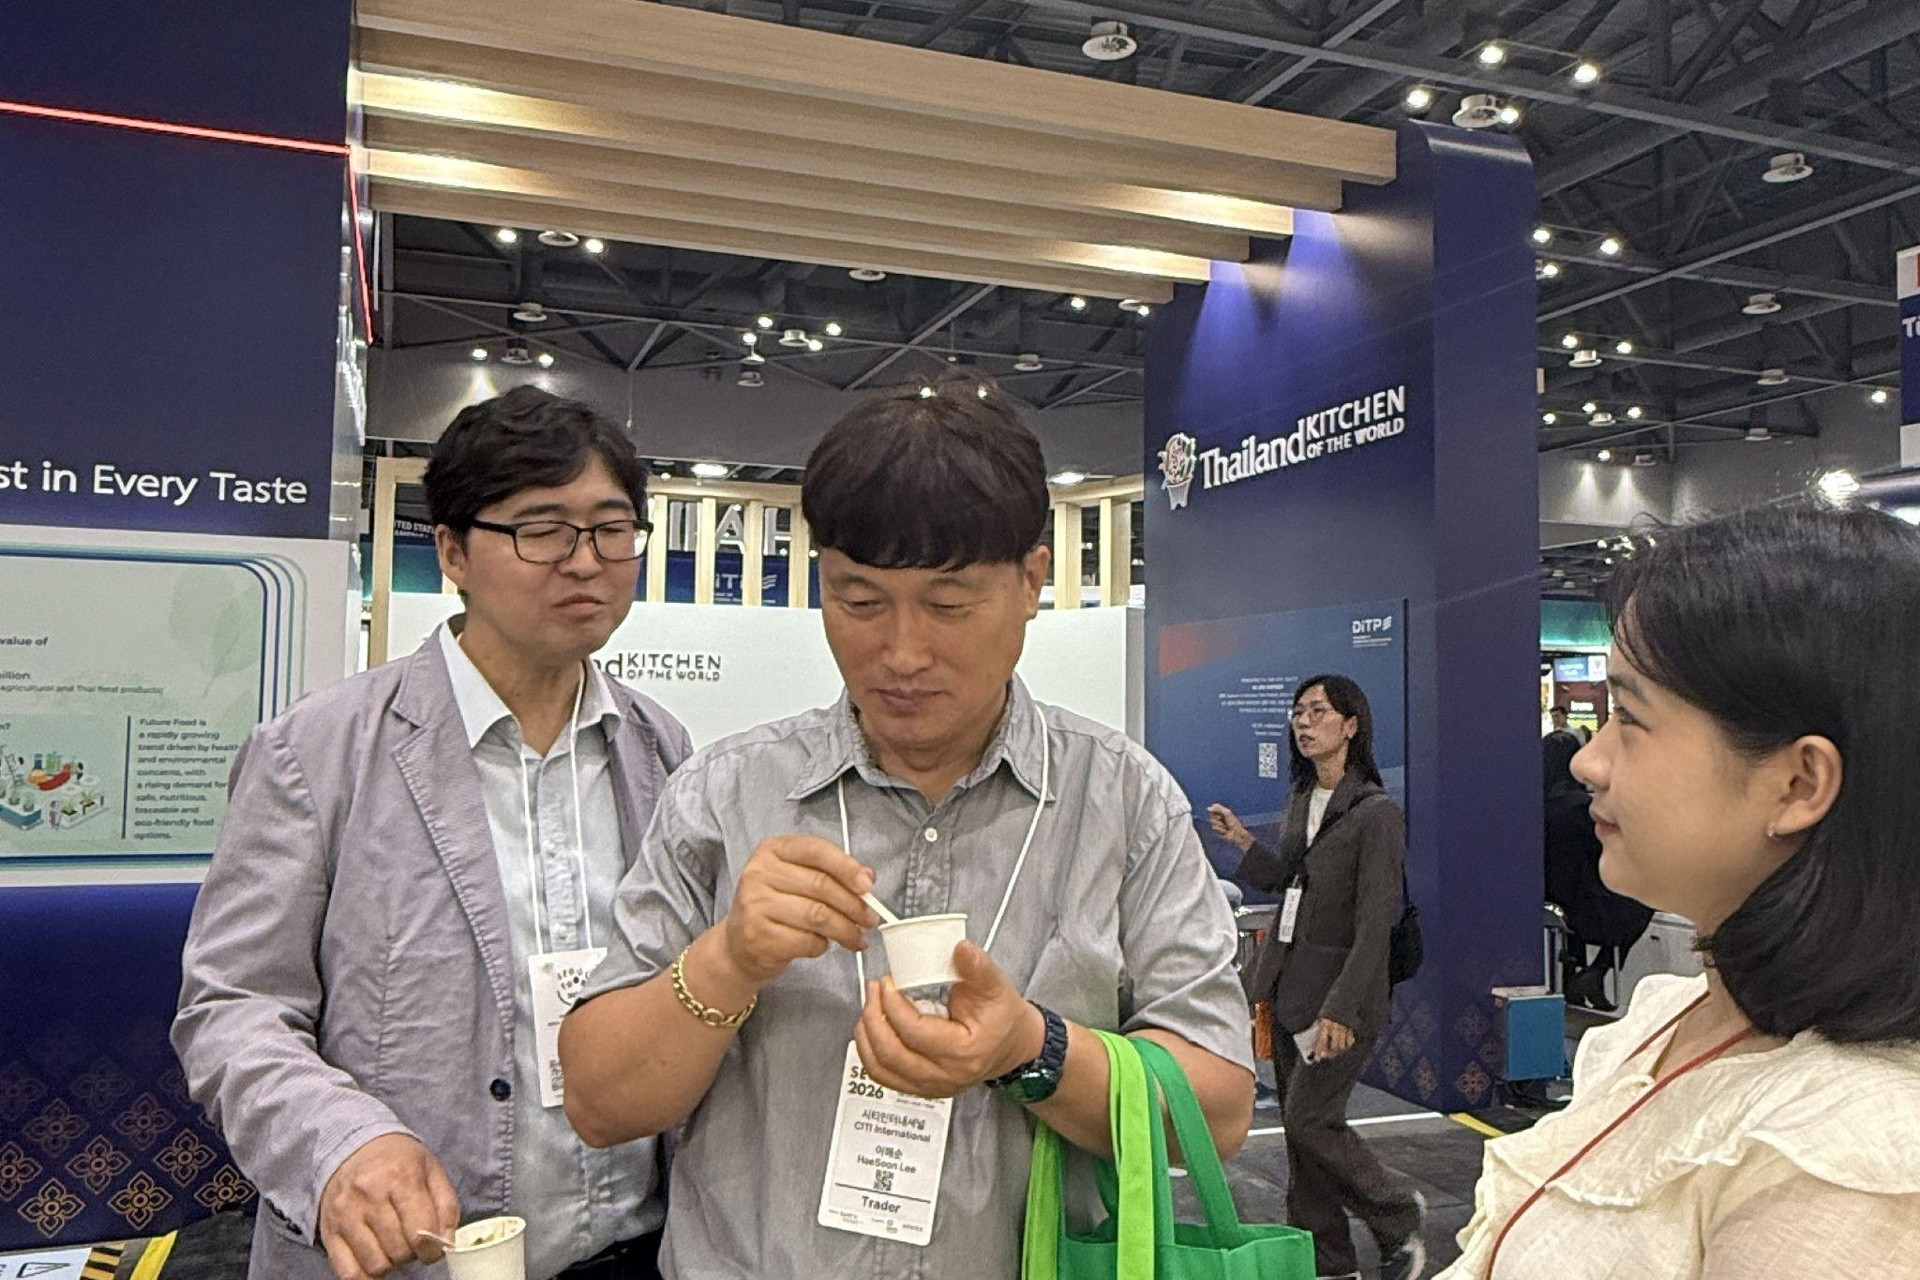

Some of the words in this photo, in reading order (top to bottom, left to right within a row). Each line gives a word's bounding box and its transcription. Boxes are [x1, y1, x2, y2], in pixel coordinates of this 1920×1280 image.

[1306, 385, 1405, 440] KITCHEN
[1307, 441, 1325, 459] OF
[1326, 433, 1353, 454] THE
[1354, 417, 1405, 445] WORLD
[1199, 418, 1306, 490] Thailand
[42, 461, 77, 492] in
[93, 464, 199, 506] Every
[209, 471, 307, 504] Taste
[35, 636, 49, 646] of
[627, 652, 721, 670] KITCHEN
[627, 669, 643, 680] OF
[648, 670, 672, 680] THE
[676, 671, 720, 682] WORLD
[848, 1081, 884, 1099] 2026
[874, 1127, 931, 1143] International
[899, 1162, 917, 1174] Lee
[862, 1196, 901, 1213] Trader
